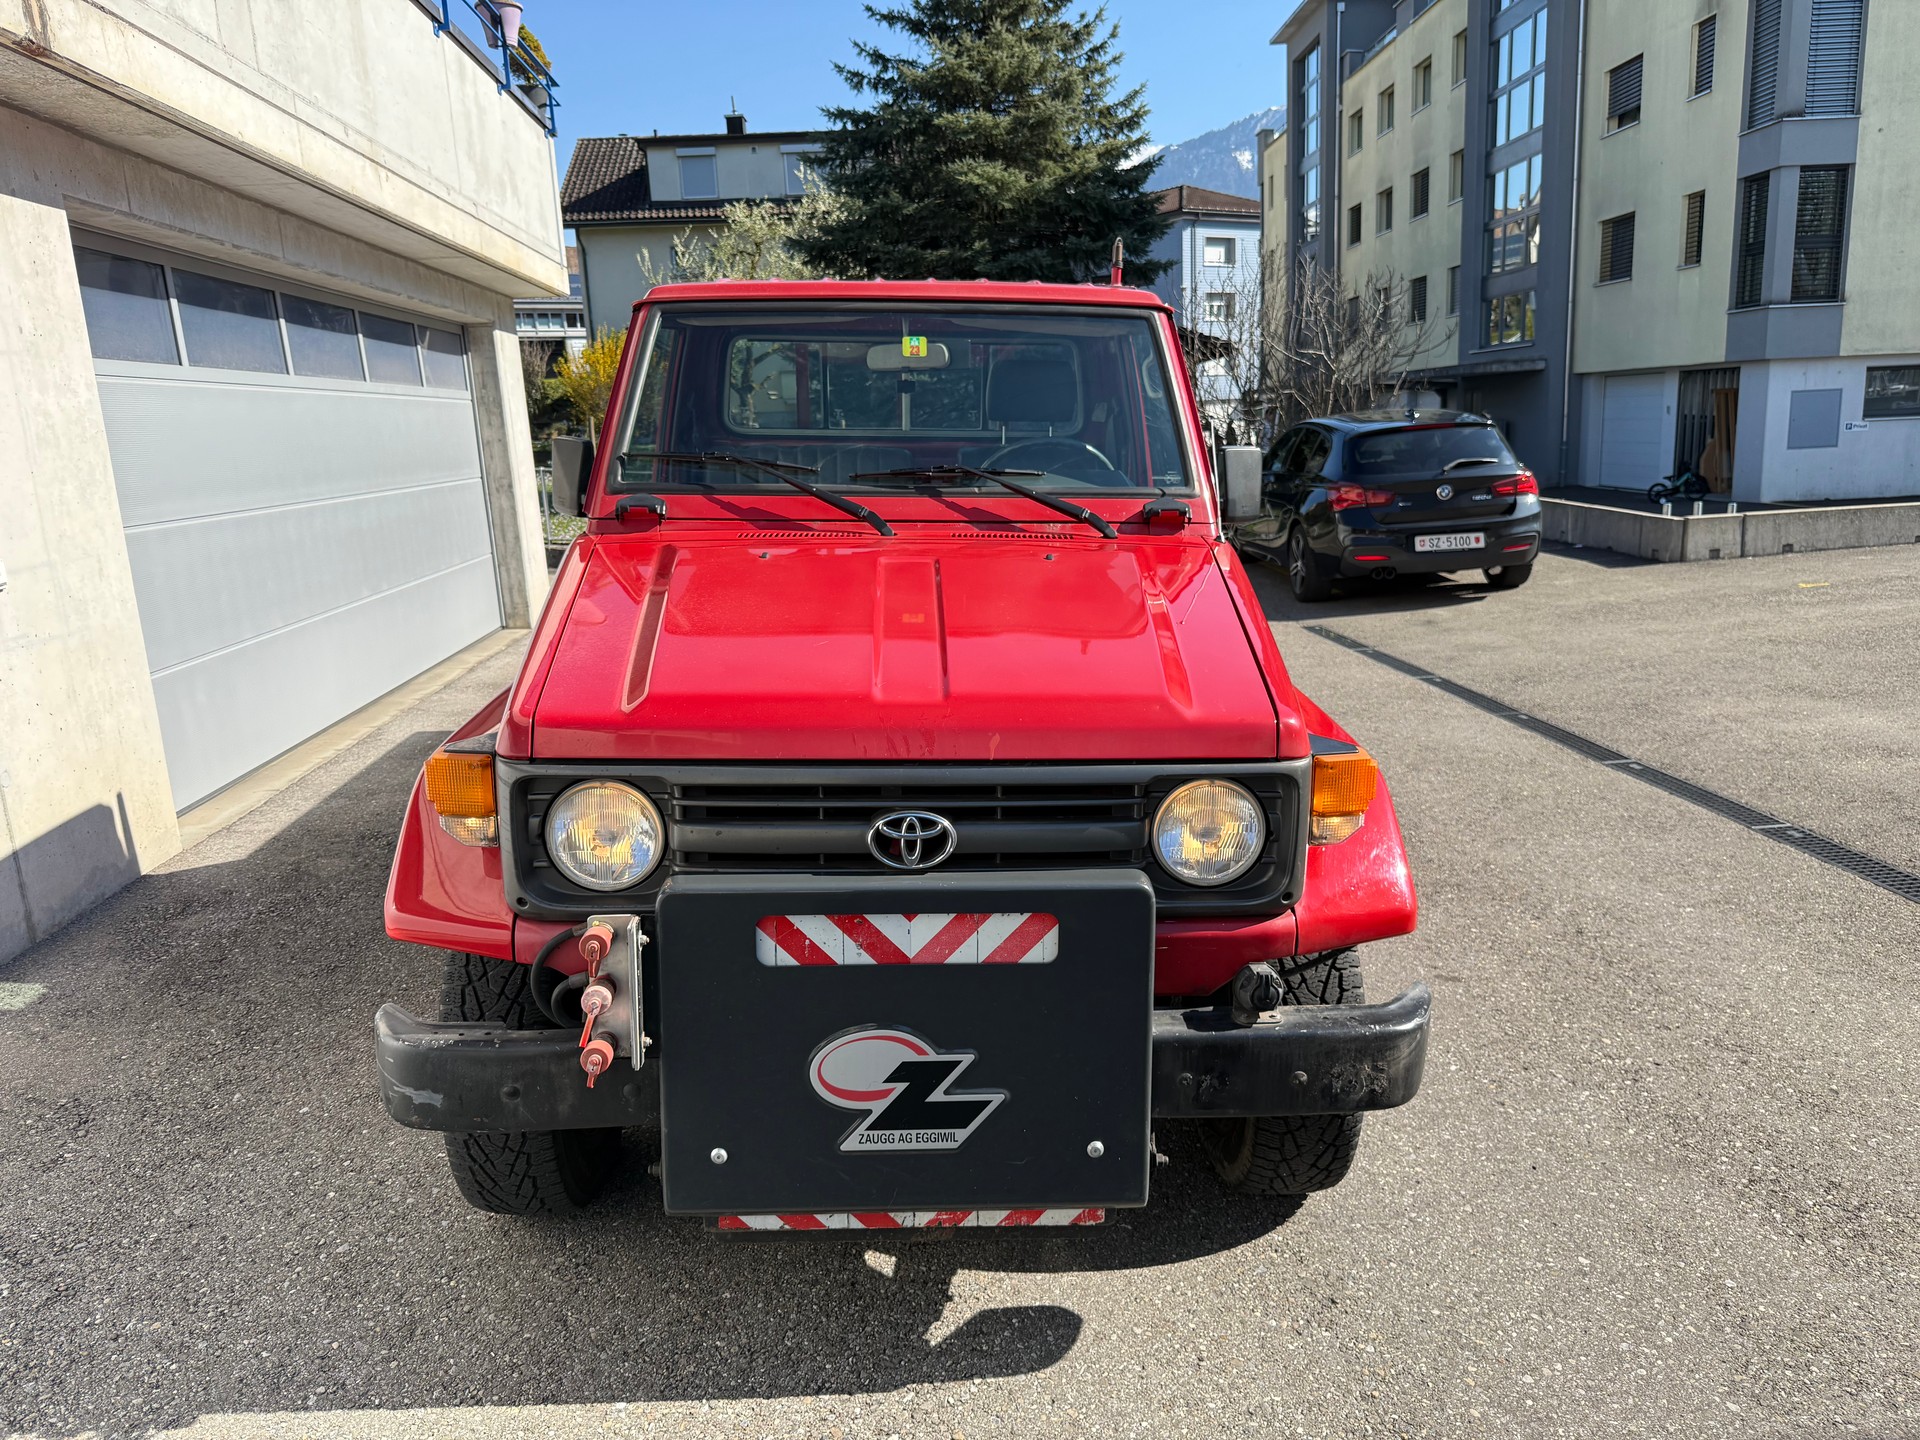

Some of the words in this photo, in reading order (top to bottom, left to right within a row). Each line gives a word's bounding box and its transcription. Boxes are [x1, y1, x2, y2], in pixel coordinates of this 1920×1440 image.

[909, 345, 920, 354] 23
[858, 1133, 895, 1144] ZAUGG
[898, 1133, 913, 1144] AG
[916, 1132, 959, 1143] EGGIWIL
